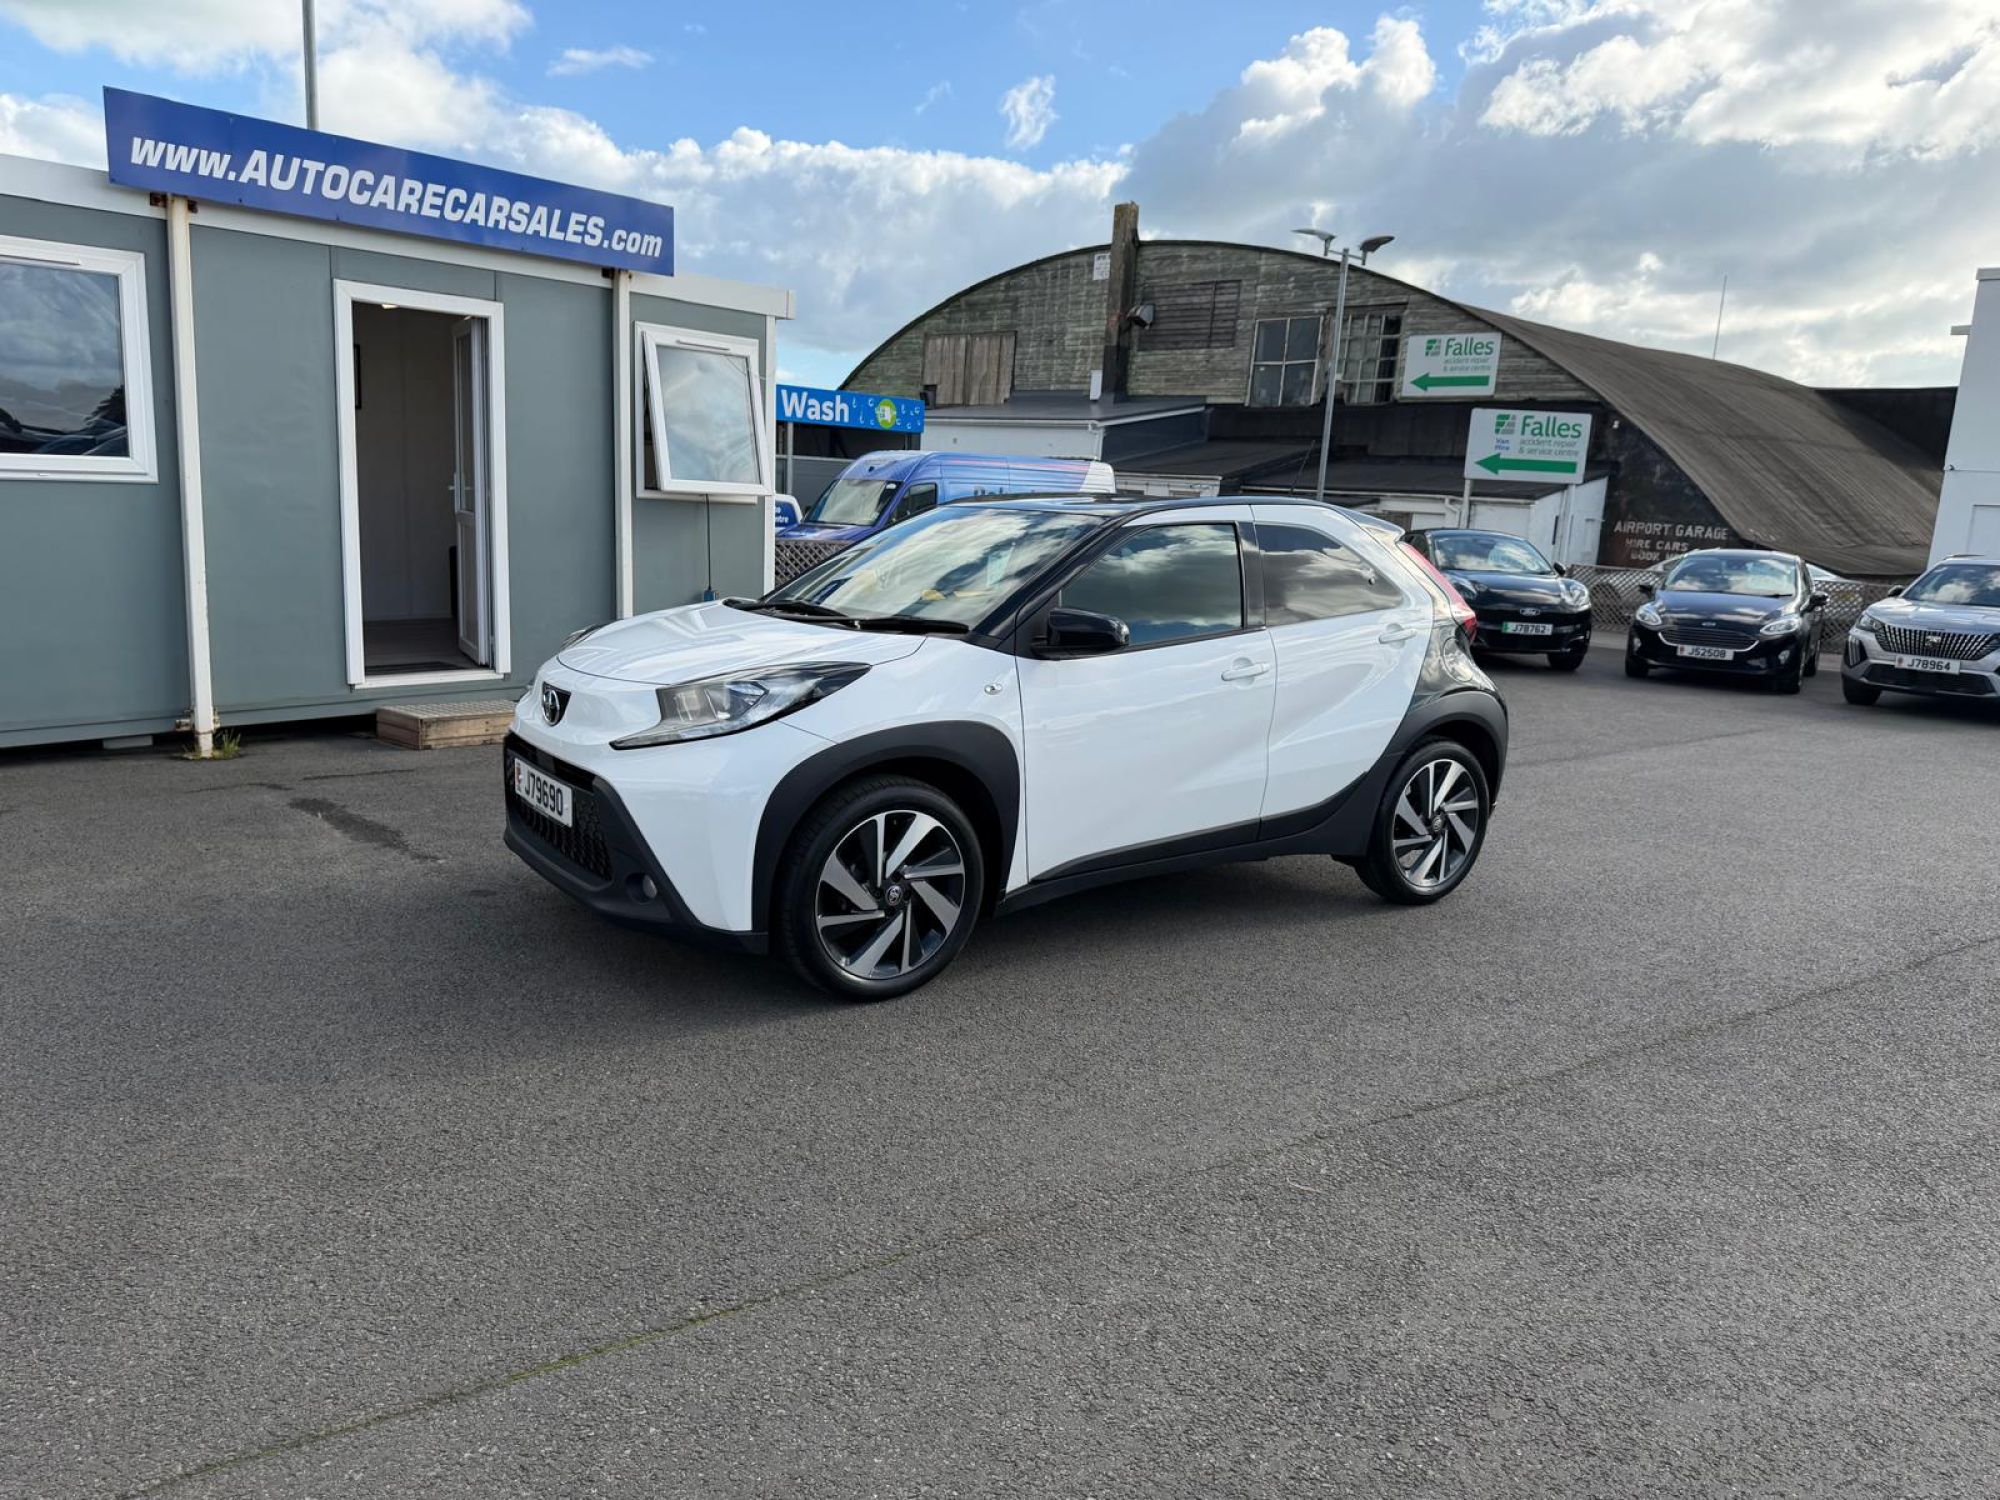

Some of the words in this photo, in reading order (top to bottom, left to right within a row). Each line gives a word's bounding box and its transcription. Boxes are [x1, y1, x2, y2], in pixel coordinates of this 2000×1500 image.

[130, 137, 662, 258] www.AUTOCARECARSALES.com
[1444, 337, 1495, 357] Falles
[781, 389, 850, 423] Wash
[1521, 414, 1583, 439] Falles
[1519, 438, 1552, 447] accident
[1553, 440, 1577, 449] repair
[1526, 447, 1552, 456] service
[1554, 448, 1579, 457] centre
[1613, 520, 1672, 536] AIRPORT
[1675, 524, 1729, 541] GARAGE
[1625, 538, 1652, 550] HIRE
[1656, 540, 1690, 552] CARS
[1907, 658, 1951, 671] J78964
[524, 769, 563, 817] J79690
